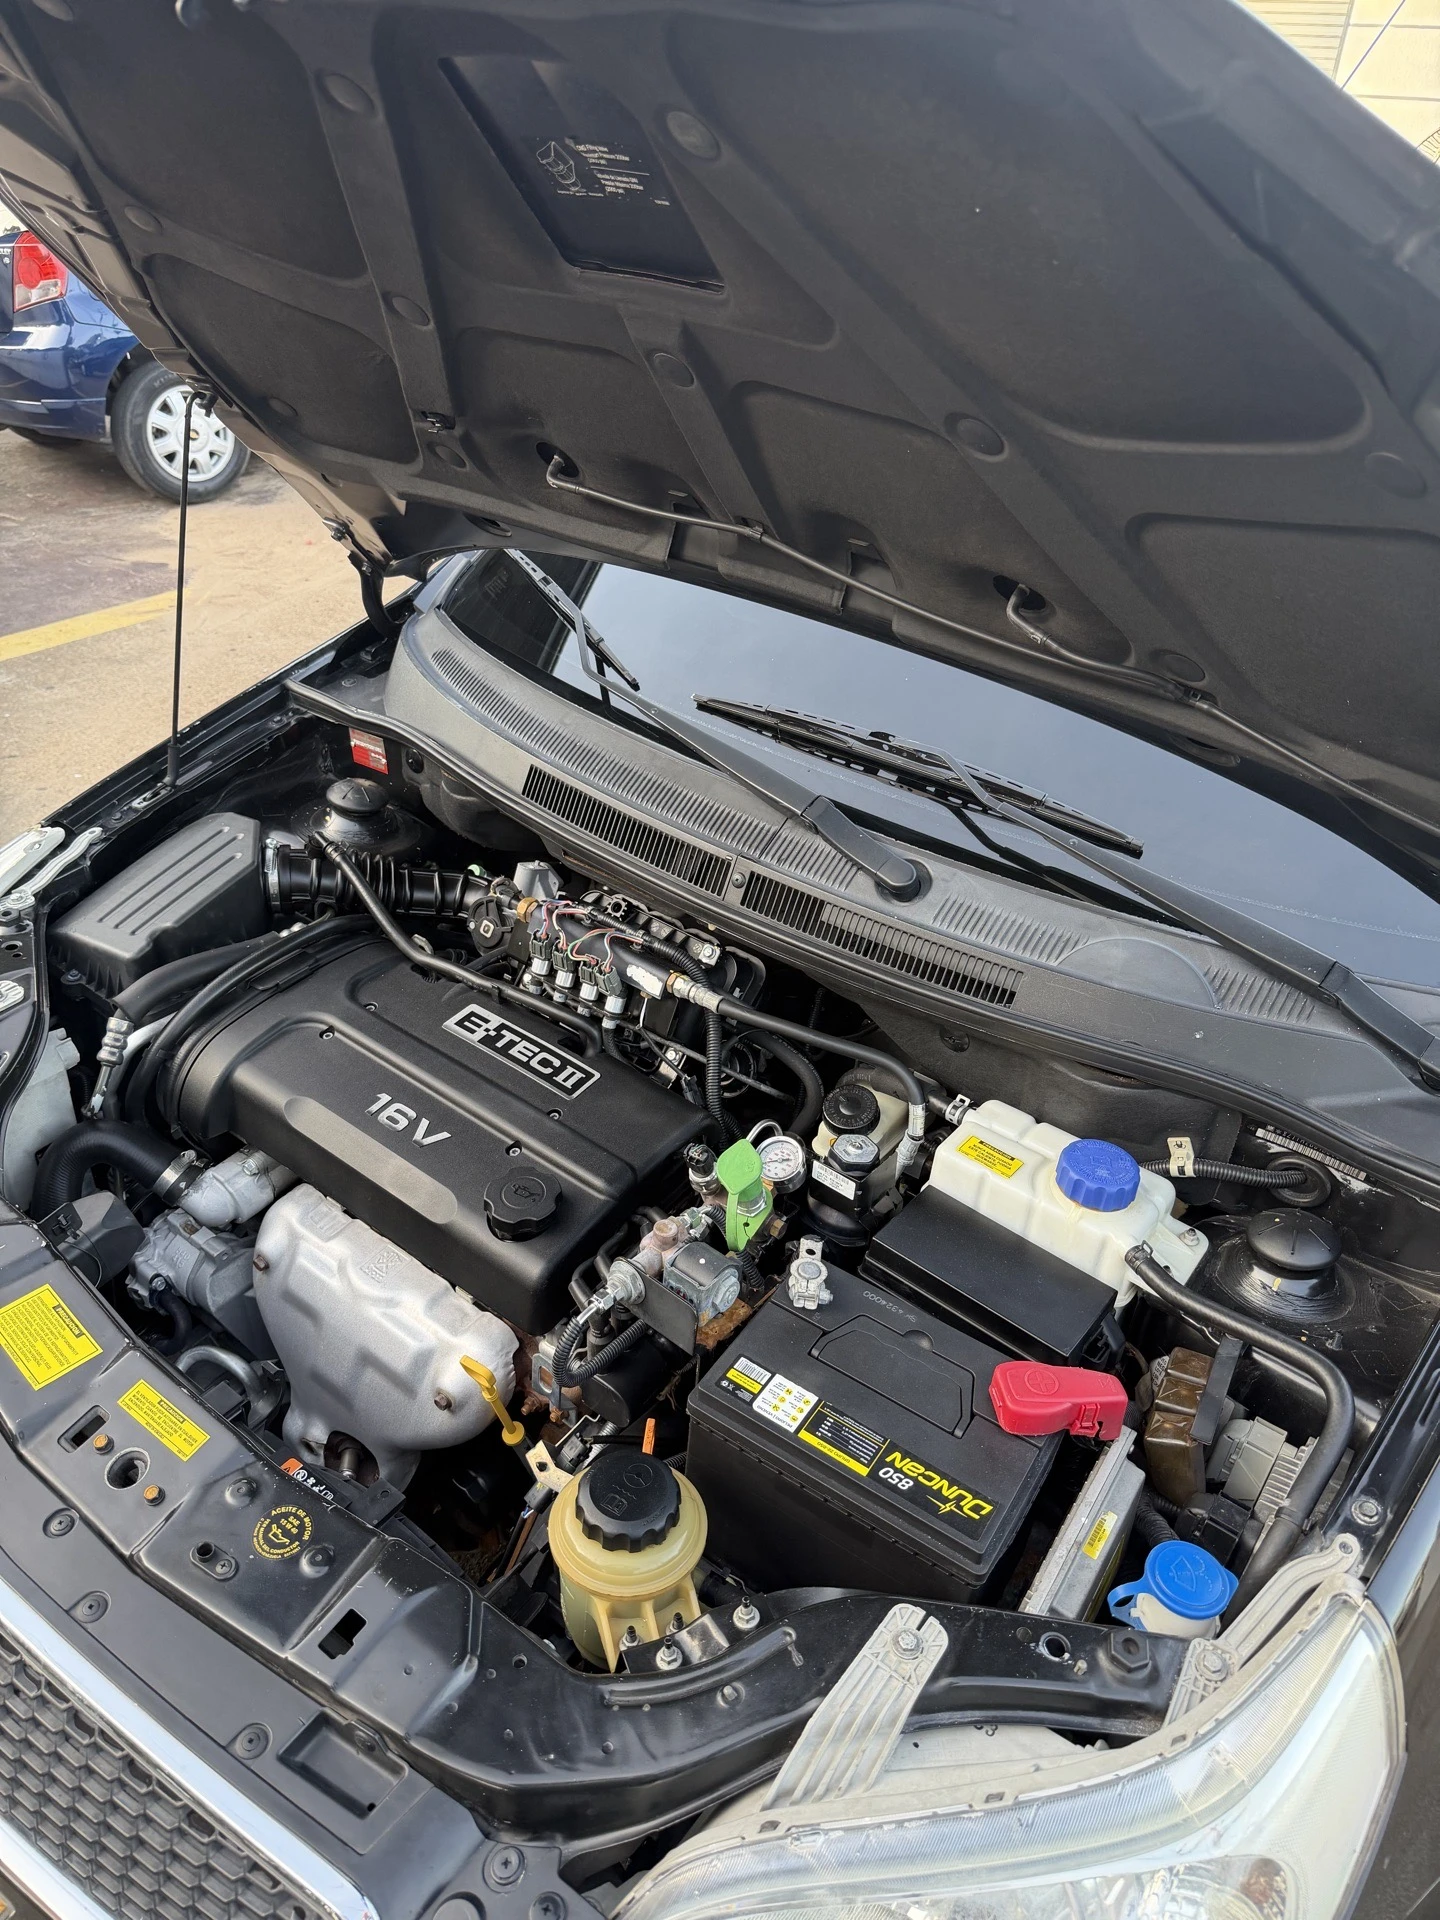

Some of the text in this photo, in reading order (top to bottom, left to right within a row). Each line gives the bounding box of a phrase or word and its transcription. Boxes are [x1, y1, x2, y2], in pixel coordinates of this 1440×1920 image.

[365, 1092, 451, 1148] 16V
[55, 1307, 81, 1335] PRECAUCION
[159, 1400, 184, 1422] PRECAUCION
[877, 1465, 914, 1491] 850
[271, 1507, 311, 1540] ACEITE DE MOTOR
[288, 1516, 300, 1526] SAE
